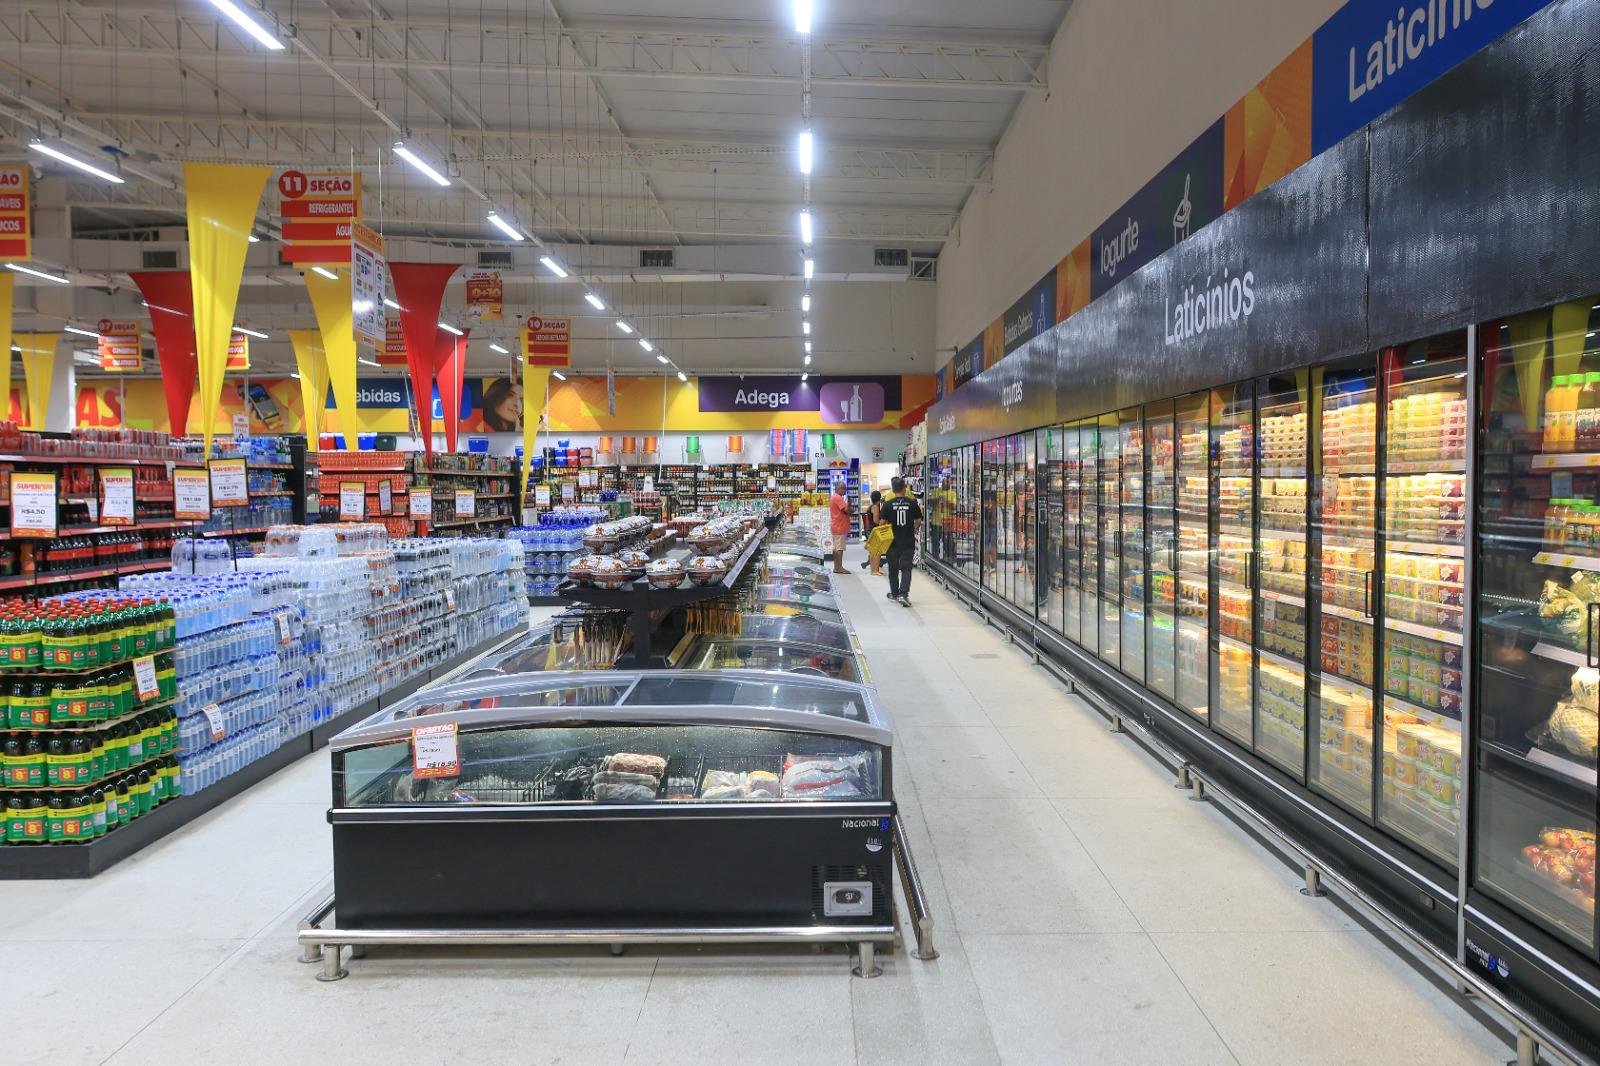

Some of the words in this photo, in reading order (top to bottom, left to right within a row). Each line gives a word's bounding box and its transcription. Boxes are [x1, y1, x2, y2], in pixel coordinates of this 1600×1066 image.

[283, 176, 302, 192] 11
[310, 176, 352, 195] SEÇÃO
[308, 202, 353, 214] REFRIGERANTES
[1100, 216, 1139, 277] Iogurte
[1165, 267, 1255, 346] Laticínios
[543, 321, 566, 331] SEÇÃO
[355, 388, 401, 404] ebidas
[735, 389, 790, 408] Adega
[896, 510, 906, 526] 10
[842, 818, 879, 828] Nacional
